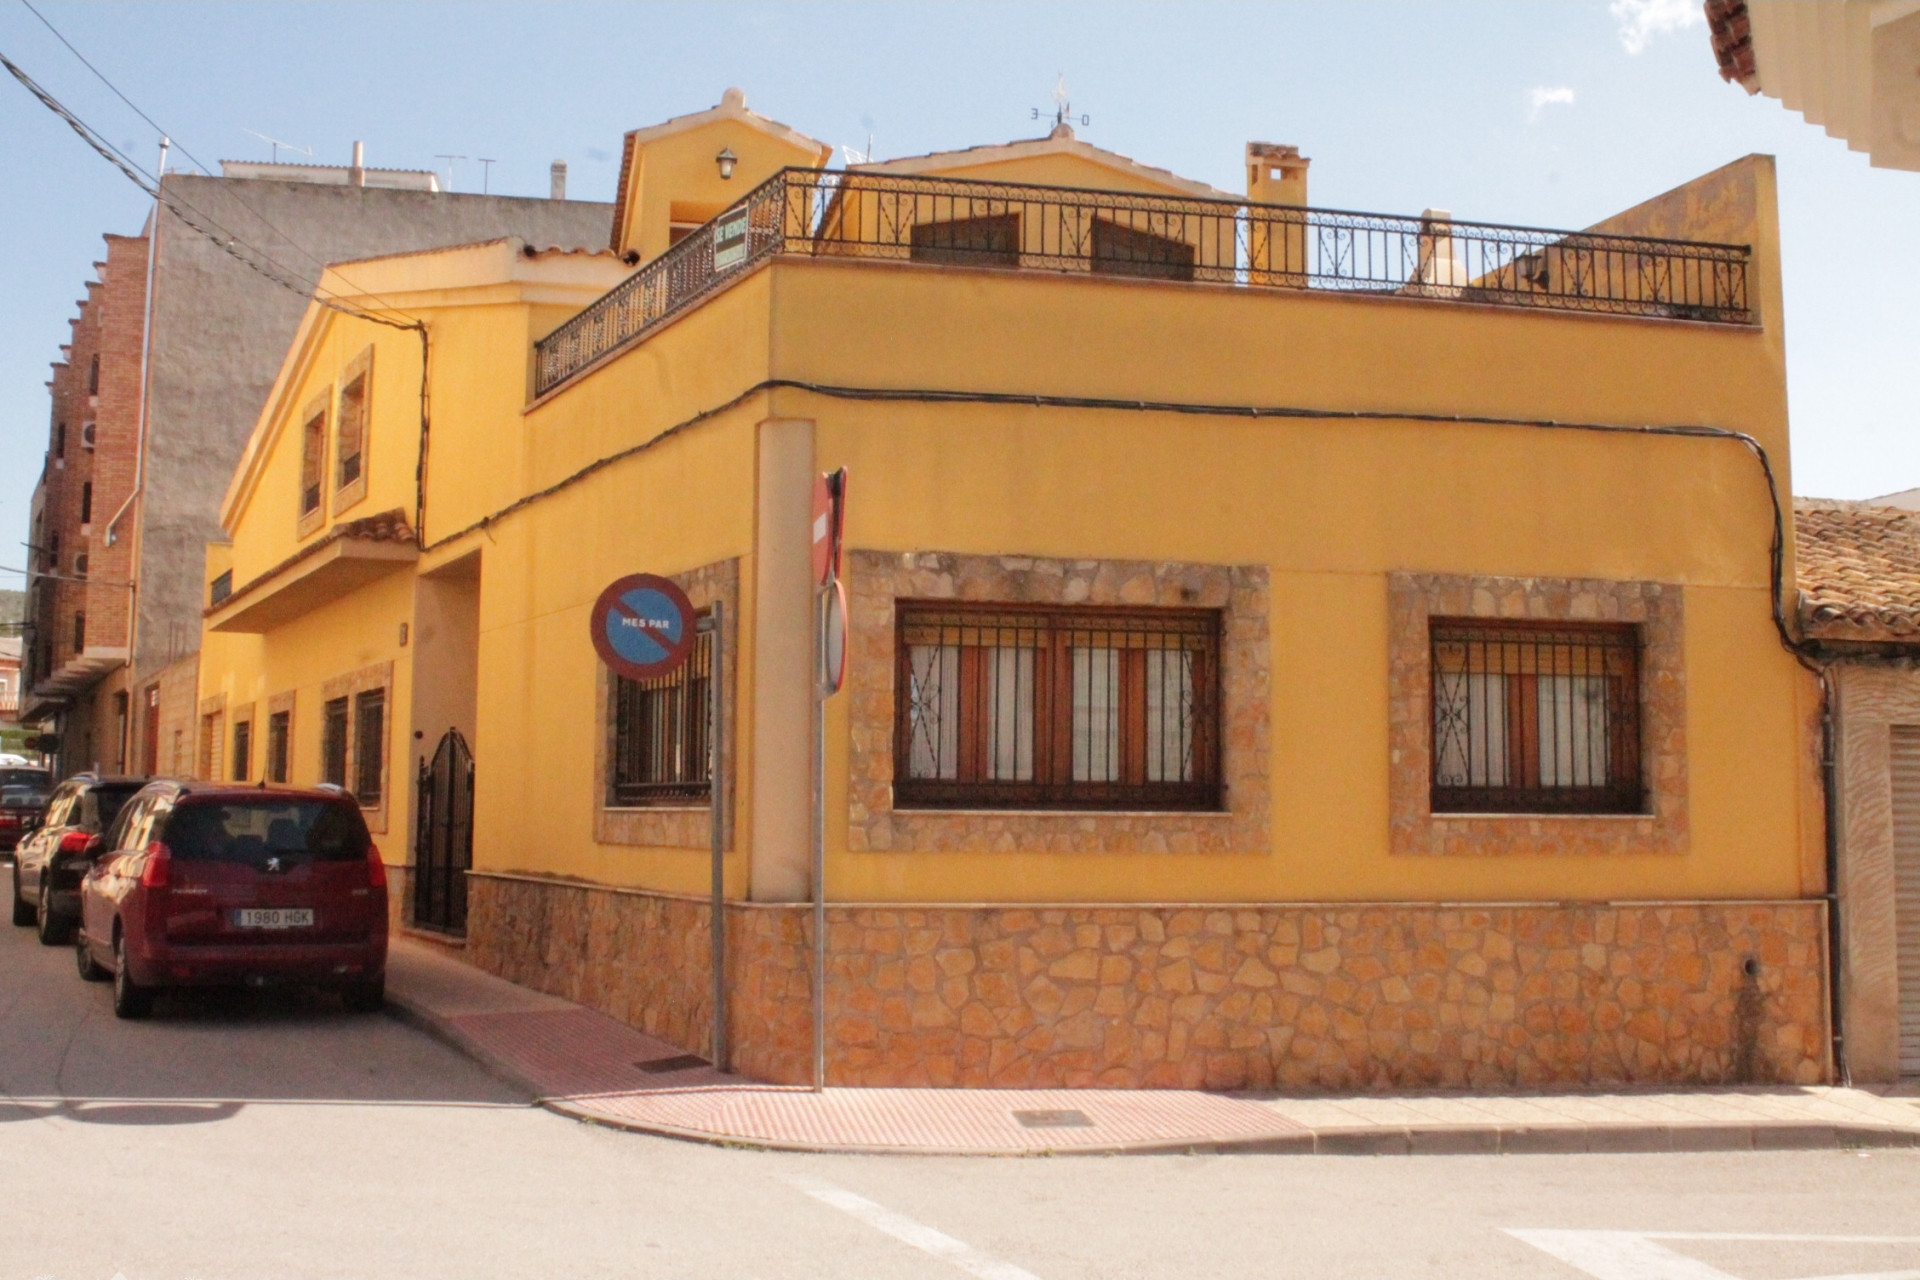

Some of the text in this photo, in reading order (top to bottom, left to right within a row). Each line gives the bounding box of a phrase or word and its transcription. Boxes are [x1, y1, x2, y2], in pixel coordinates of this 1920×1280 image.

[622, 618, 670, 629] MES PAR
[246, 911, 309, 924] 1980 HGK
